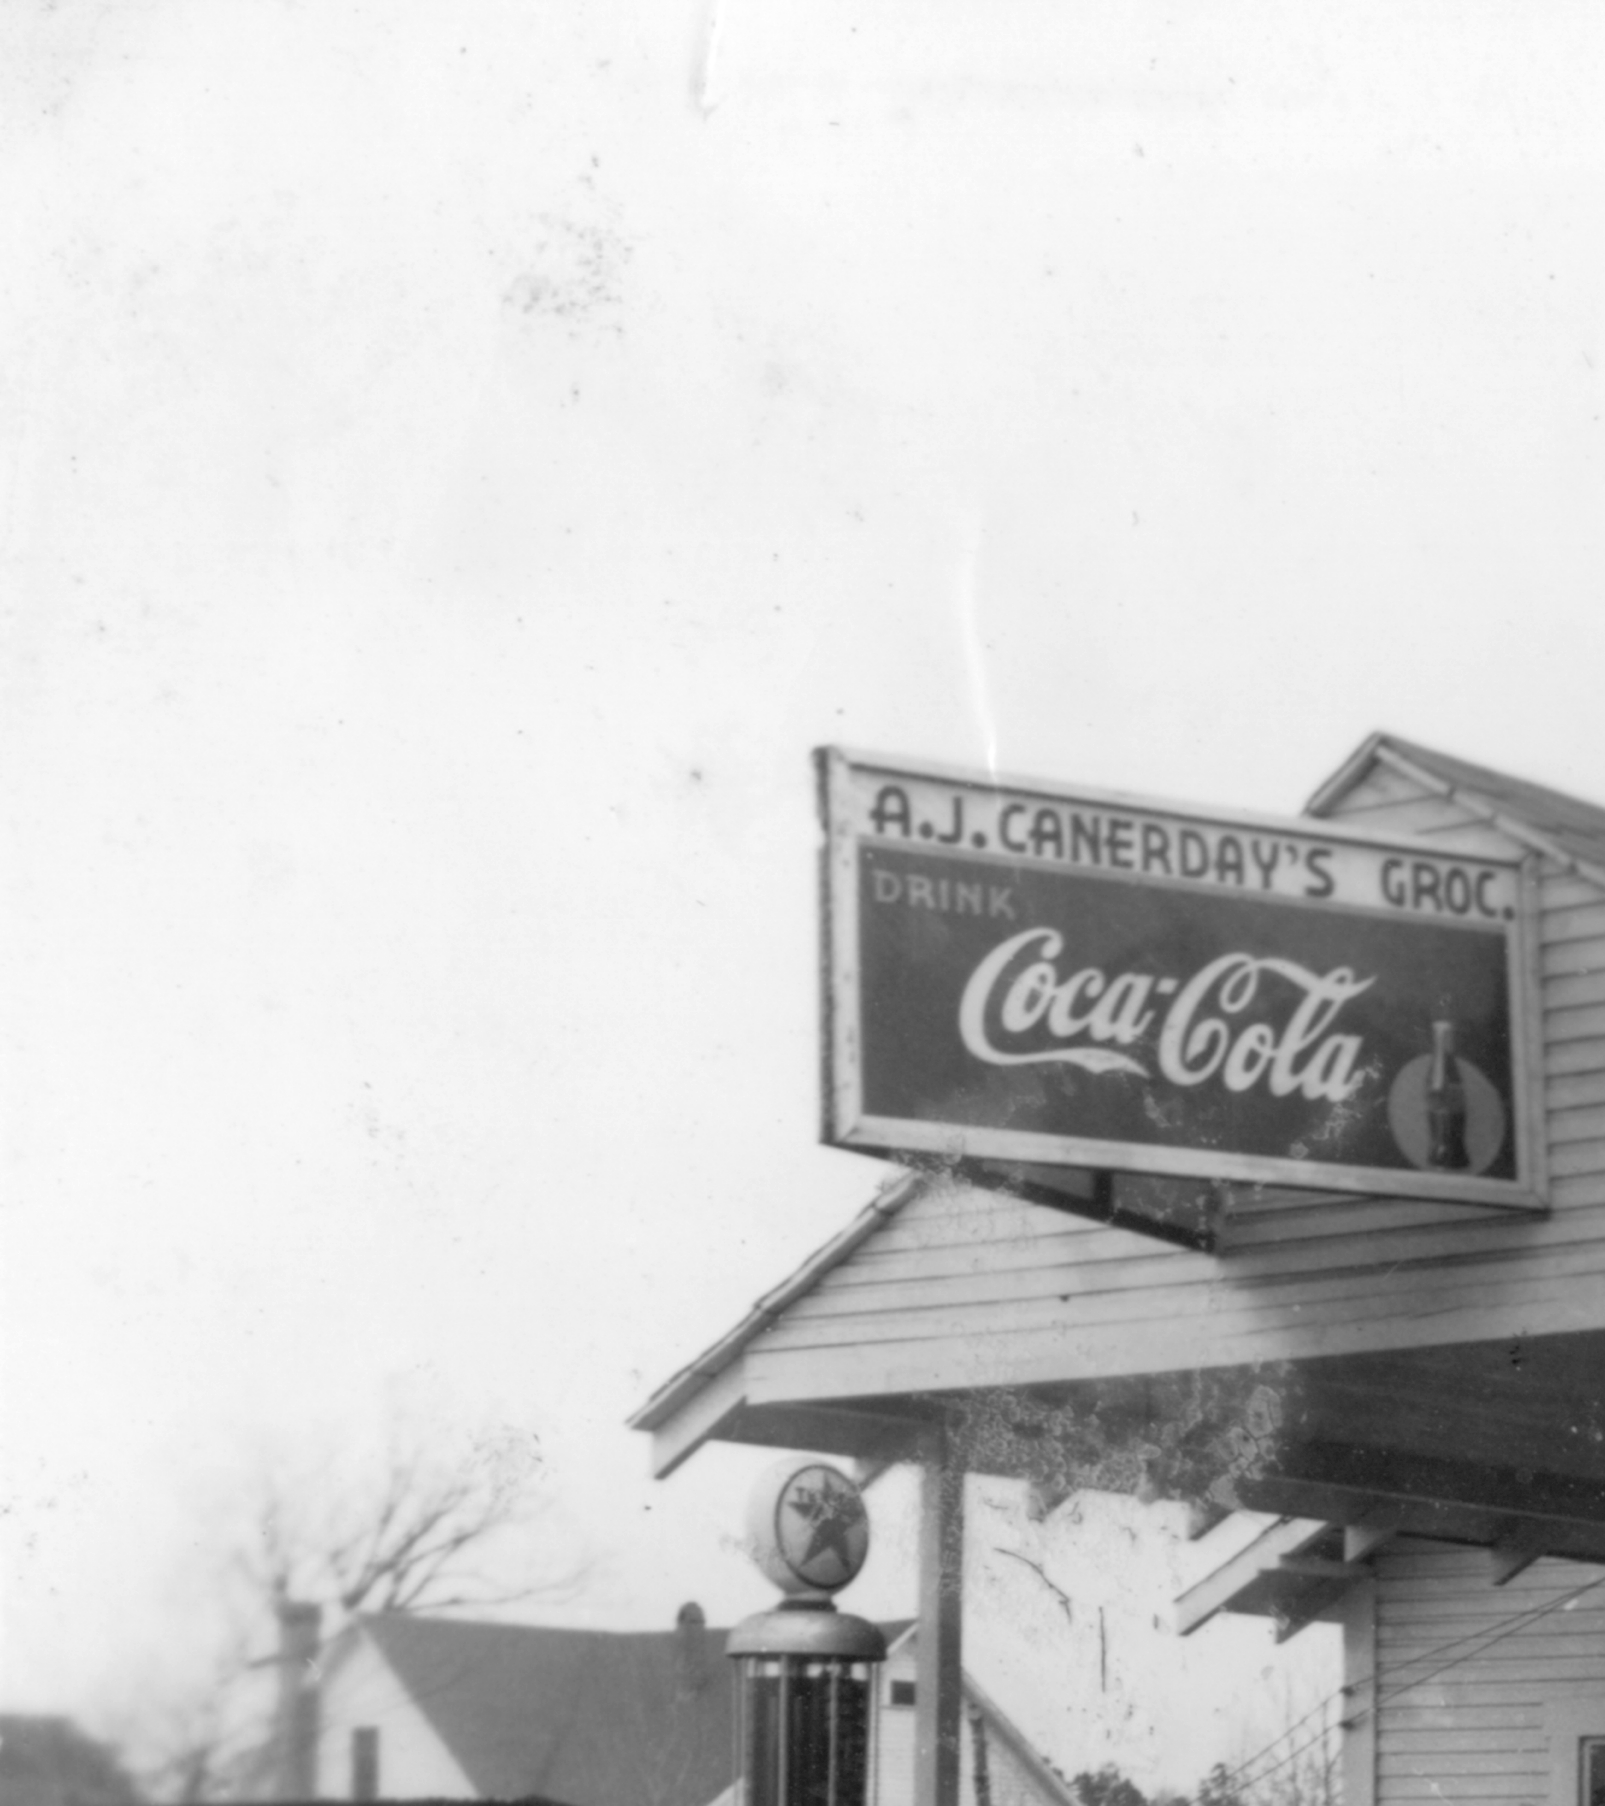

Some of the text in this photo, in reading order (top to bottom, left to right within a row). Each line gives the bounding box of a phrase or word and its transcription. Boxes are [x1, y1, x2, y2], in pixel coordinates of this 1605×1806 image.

[873, 868, 1018, 921] DRINK
[1000, 804, 1335, 899] CANERDAY'S
[1380, 857, 1517, 922] GROC.
[958, 926, 1378, 1103] Coca-Cola
